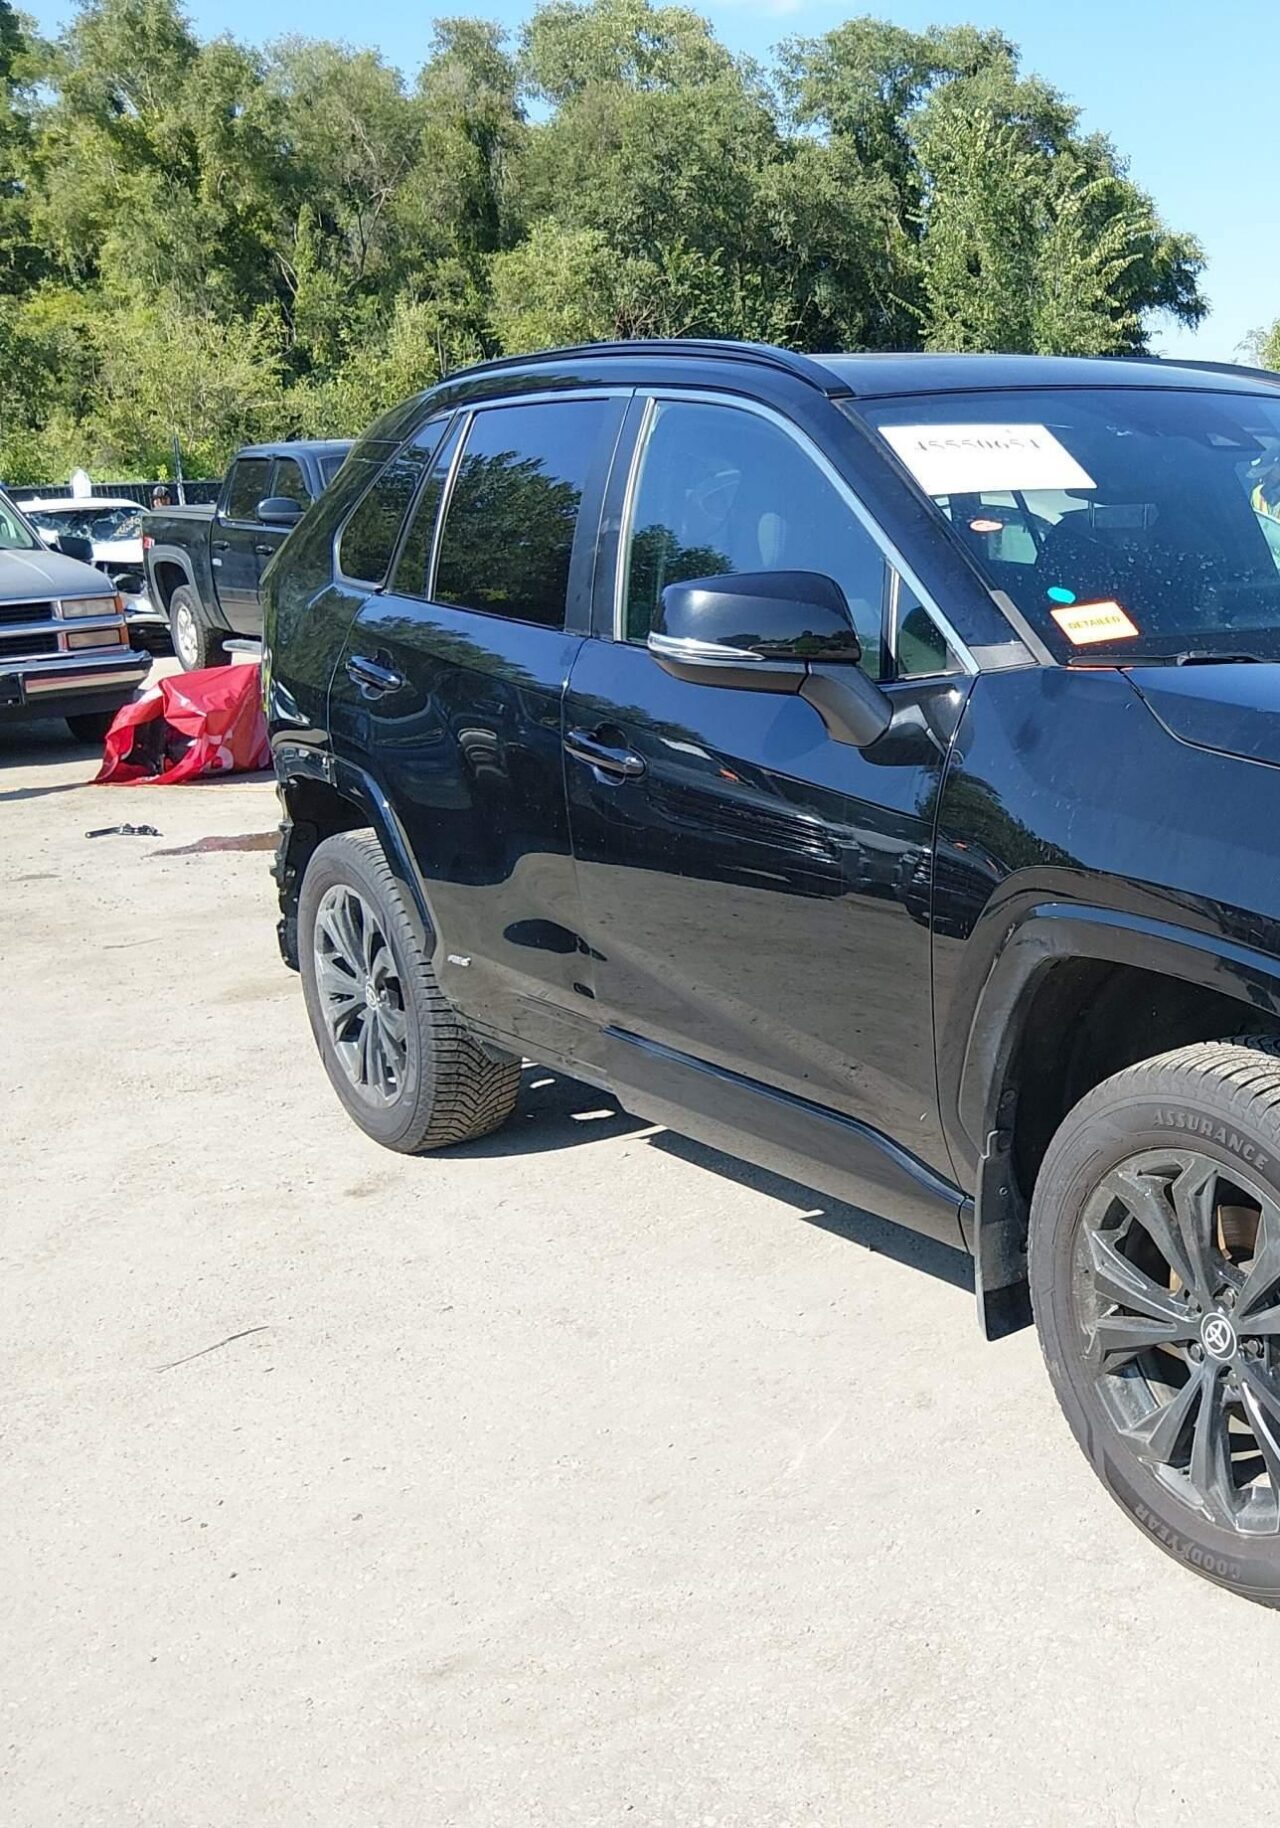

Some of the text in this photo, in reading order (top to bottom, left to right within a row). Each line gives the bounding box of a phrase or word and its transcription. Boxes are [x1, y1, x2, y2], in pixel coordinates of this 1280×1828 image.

[1067, 615, 1121, 630] DETAILED
[1154, 1107, 1270, 1171] ASSURANCE
[1135, 1502, 1241, 1579] GOODYEAR
